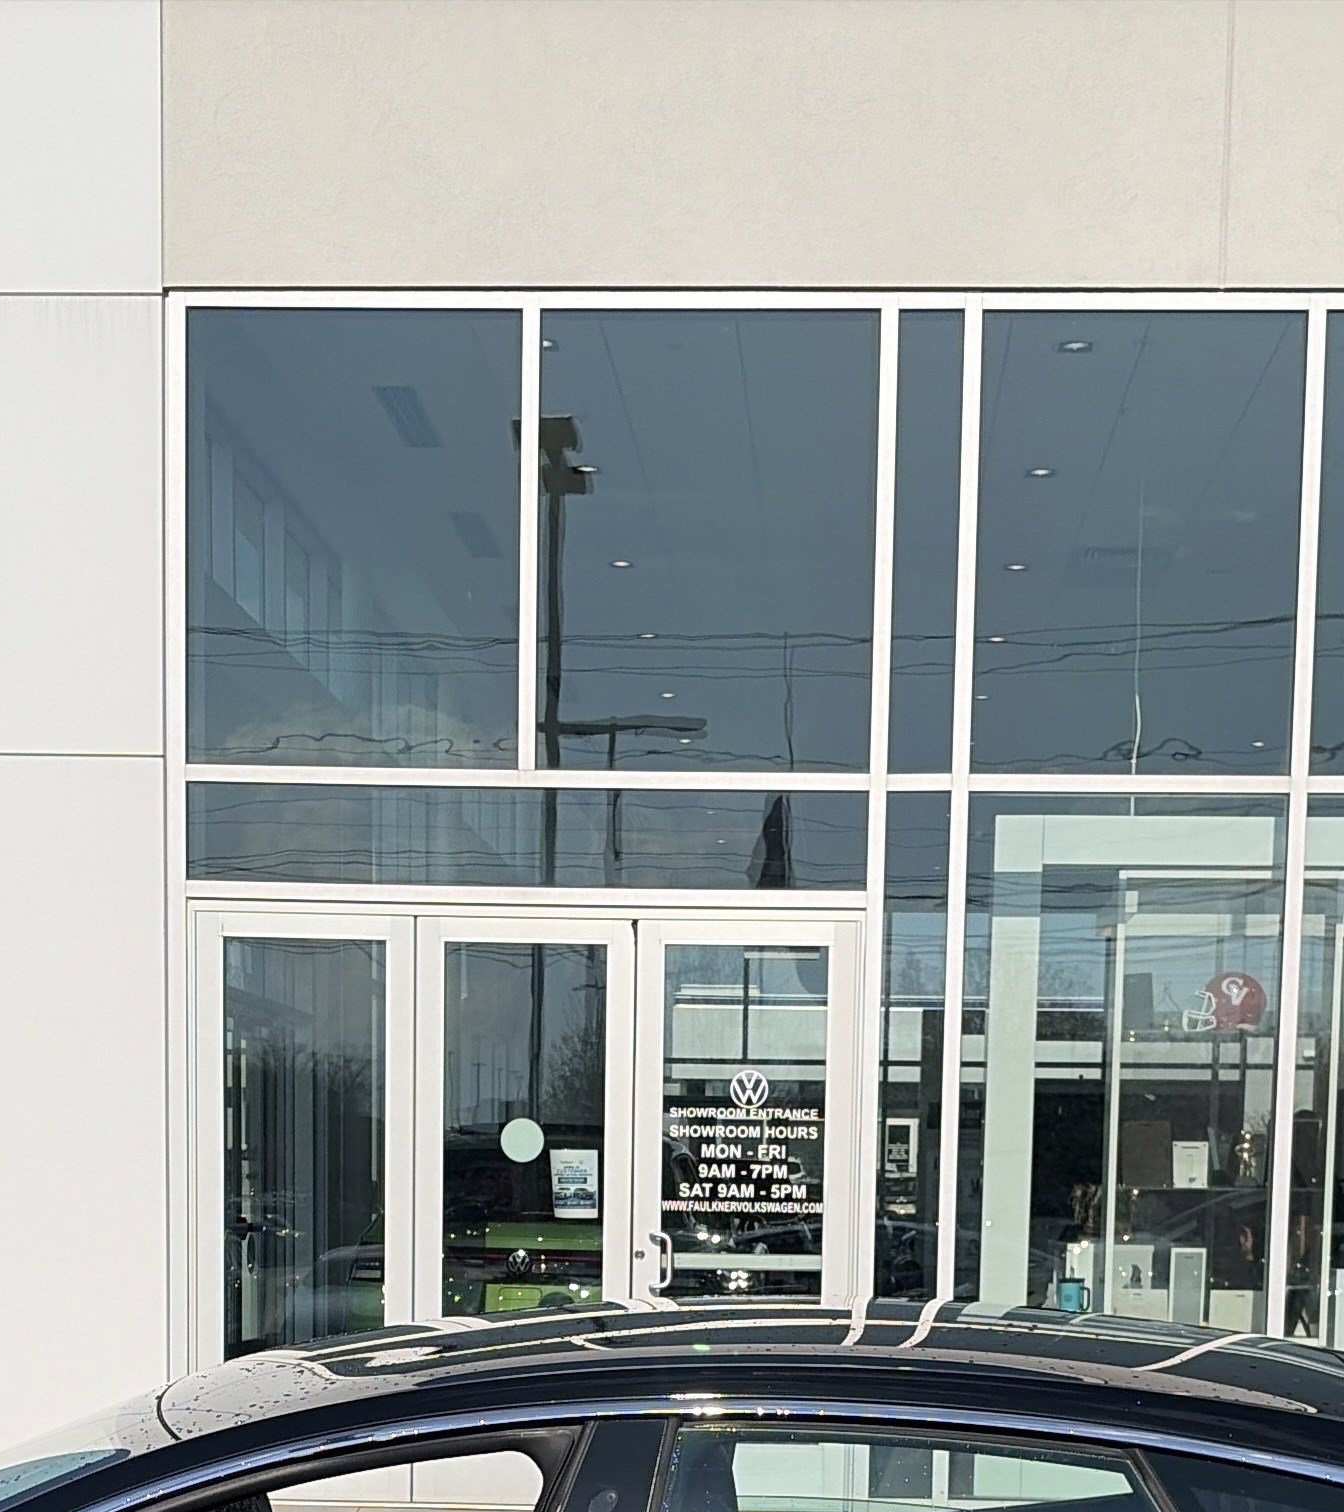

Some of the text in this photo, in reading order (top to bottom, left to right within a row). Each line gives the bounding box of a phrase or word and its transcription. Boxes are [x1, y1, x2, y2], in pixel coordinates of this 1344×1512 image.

[669, 1107, 819, 1120] SHOWROOM ENTRANCE
[669, 1125, 819, 1140] SHOWROOM HOURS
[701, 1143, 742, 1159] MON
[757, 1144, 787, 1160] FRI
[698, 1163, 736, 1179] 9AM
[749, 1164, 788, 1180] 7PM
[678, 1182, 713, 1198] SAT
[717, 1183, 755, 1199] 9AM
[770, 1184, 807, 1200] 5PM
[662, 1200, 824, 1214] WWW.FAULKNERVOLKSWAGEN.COM
